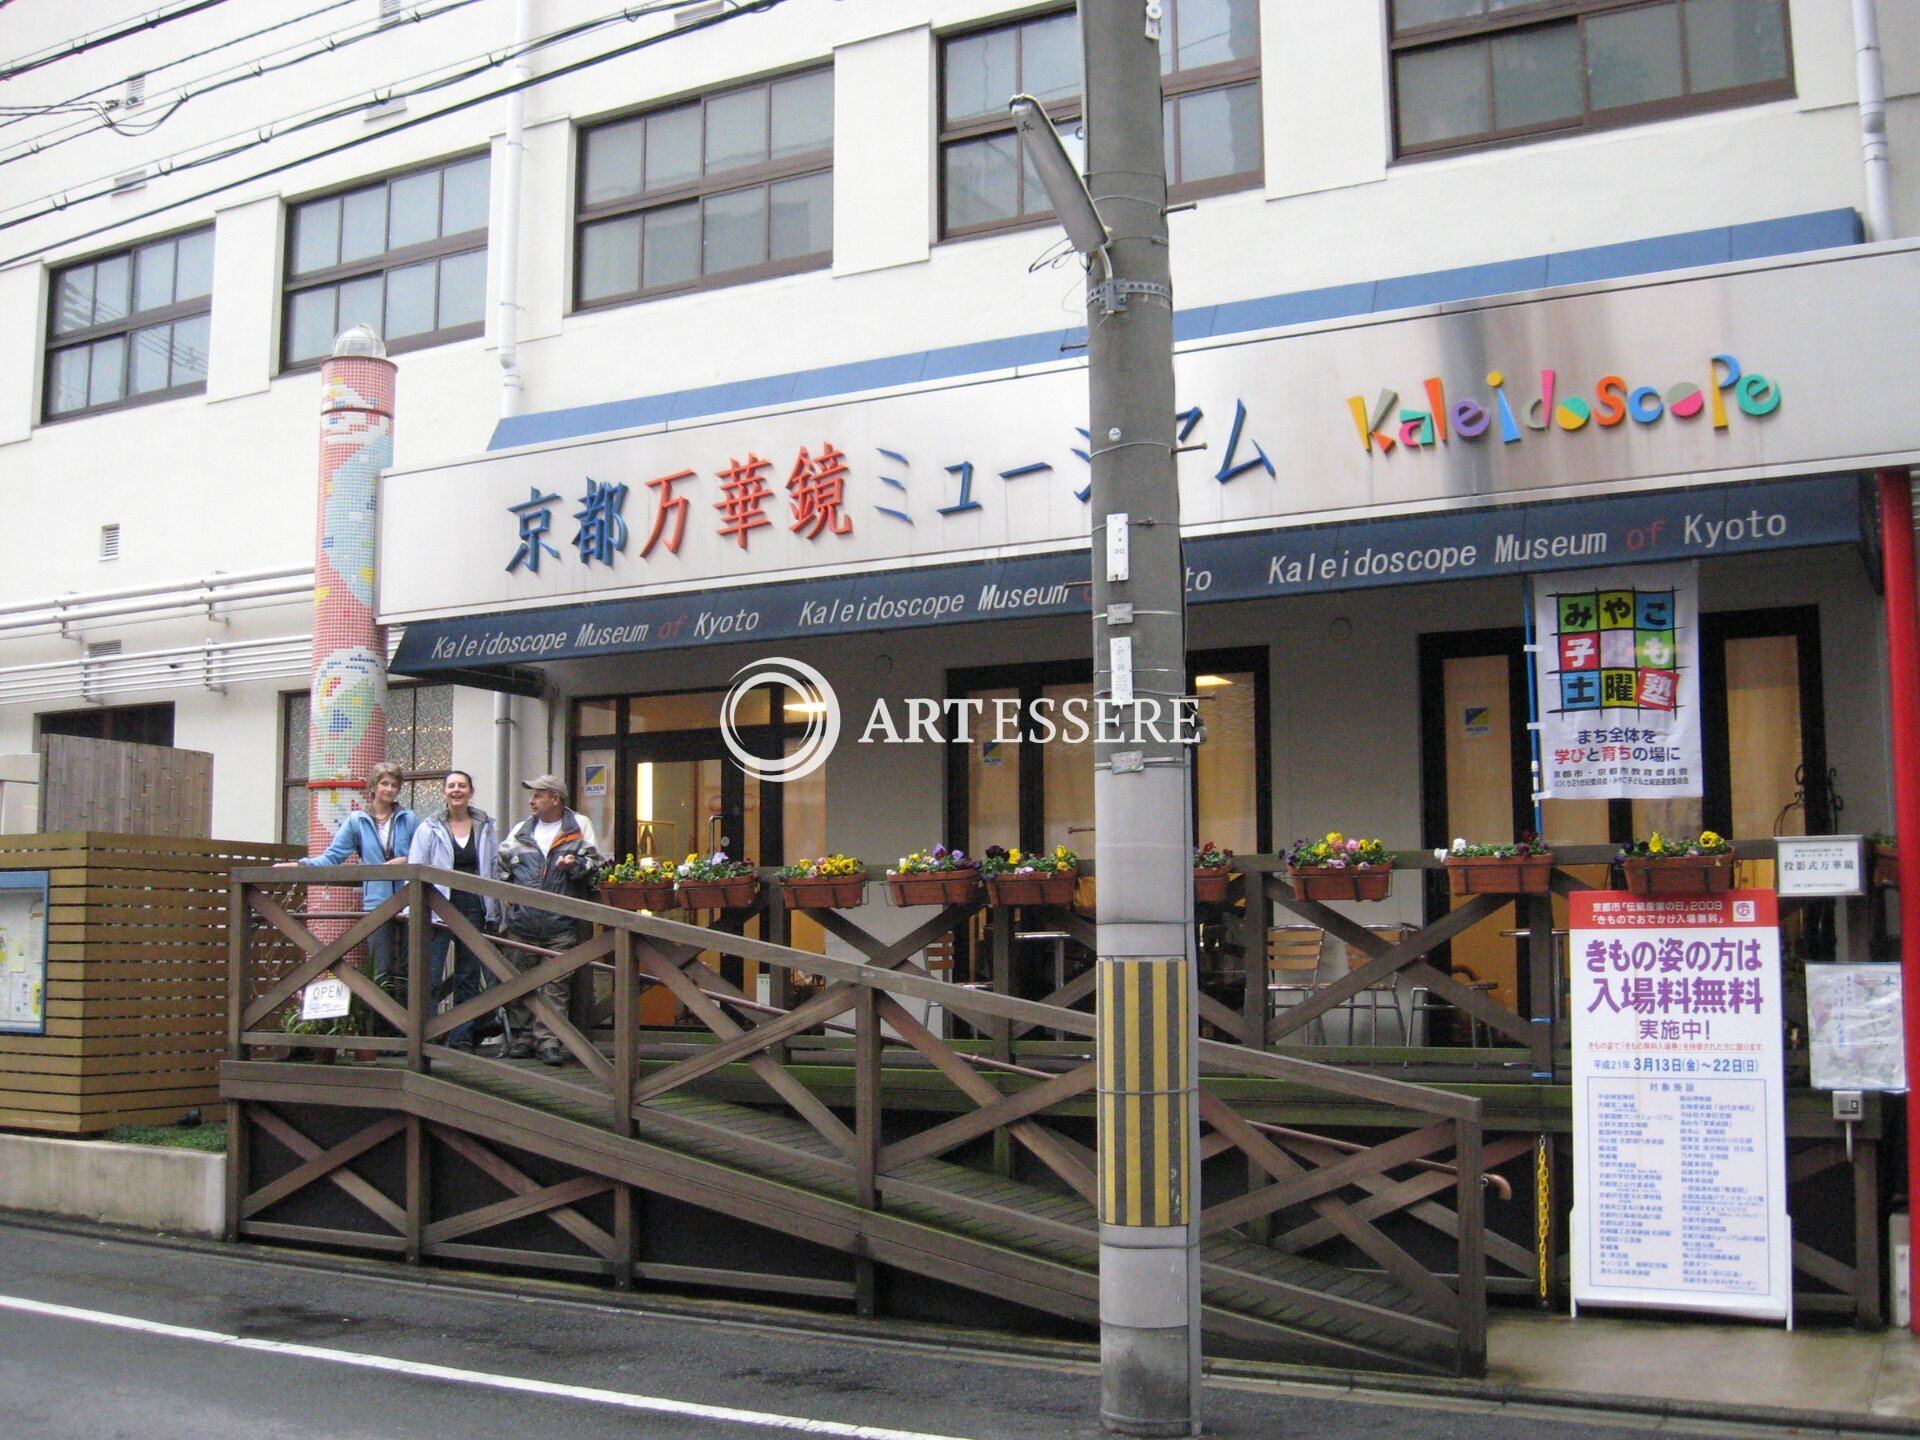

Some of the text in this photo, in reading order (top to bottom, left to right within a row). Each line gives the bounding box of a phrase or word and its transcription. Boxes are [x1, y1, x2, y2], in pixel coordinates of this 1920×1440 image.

[1347, 354, 1781, 453] Kaleidoscope
[1268, 511, 1787, 585] Kaleidoscope Museum of Kyoto
[799, 593, 964, 626] Kaleidoscope
[978, 584, 1070, 610] Museum
[1563, 597, 1668, 629] みやこ
[431, 611, 760, 659] Kaleidoscope Museum of Kyoto
[1567, 673, 1671, 706] 土曜塾
[1578, 727, 1656, 745] まち全体を
[1554, 745, 1681, 765] 学びと育ちの場に
[1784, 860, 1854, 872] 投影式万華鏡
[1586, 937, 1763, 973] きもの姿の方は
[313, 985, 343, 1000] OPEN
[1587, 976, 1764, 1015] 入場料無料
